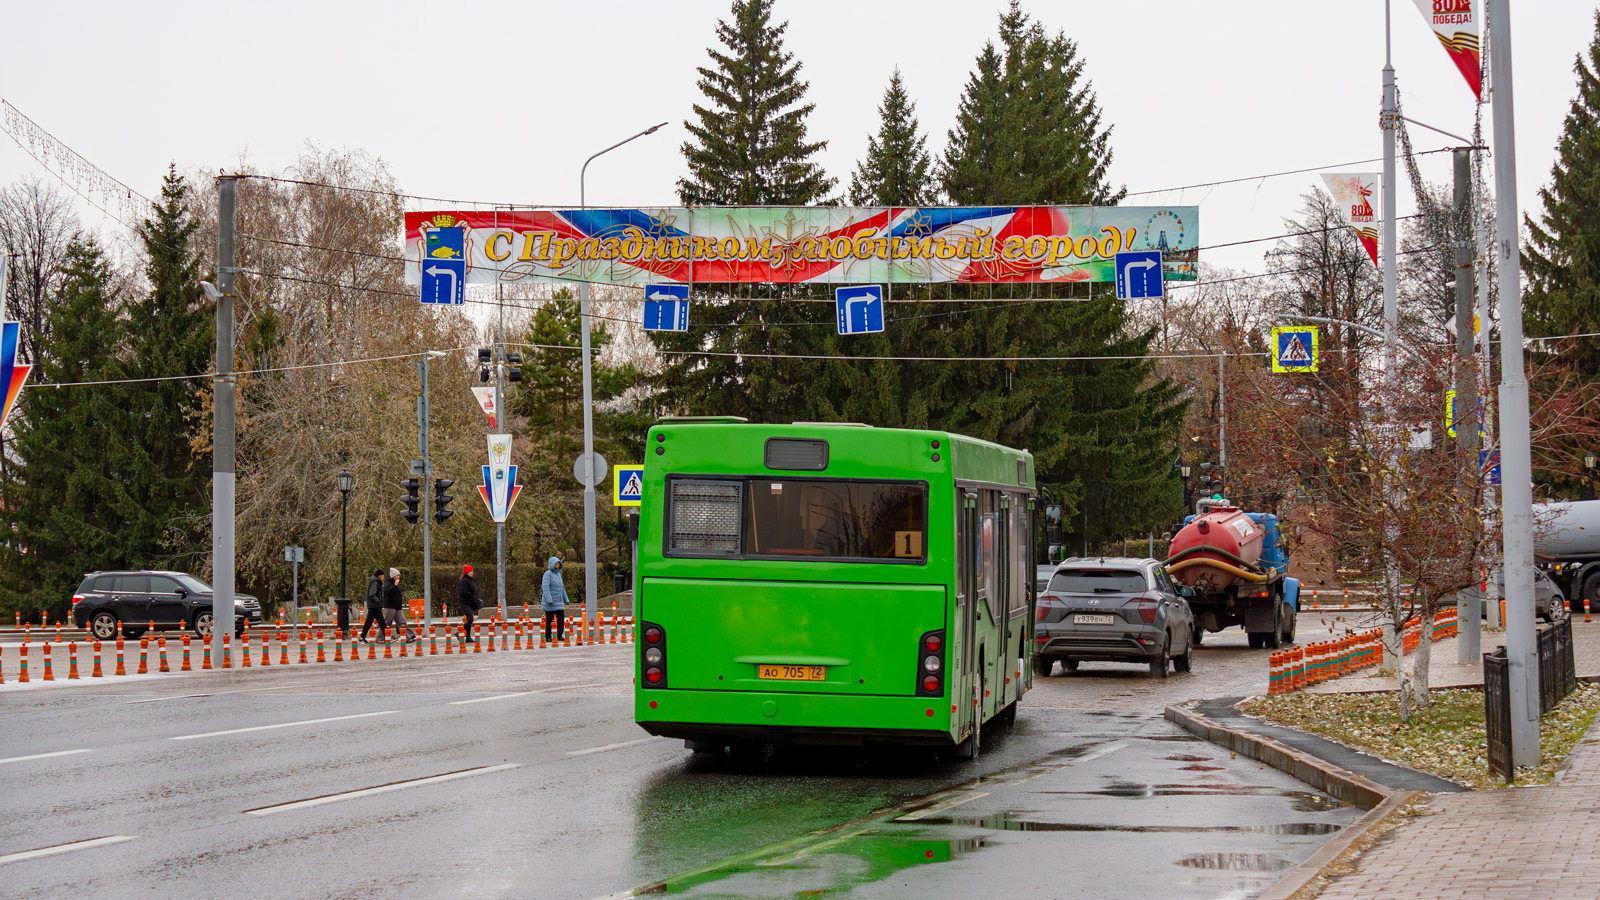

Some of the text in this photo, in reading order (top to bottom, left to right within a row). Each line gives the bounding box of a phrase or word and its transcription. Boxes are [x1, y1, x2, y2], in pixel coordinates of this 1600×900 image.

[1432, 0, 1452, 11] 80
[1432, 14, 1472, 24] ПОБЕДА!
[1351, 204, 1364, 215] 80
[484, 225, 1137, 268] С Праздником, любимый город!
[904, 534, 912, 554] 1
[764, 667, 822, 678] АО 705 72
